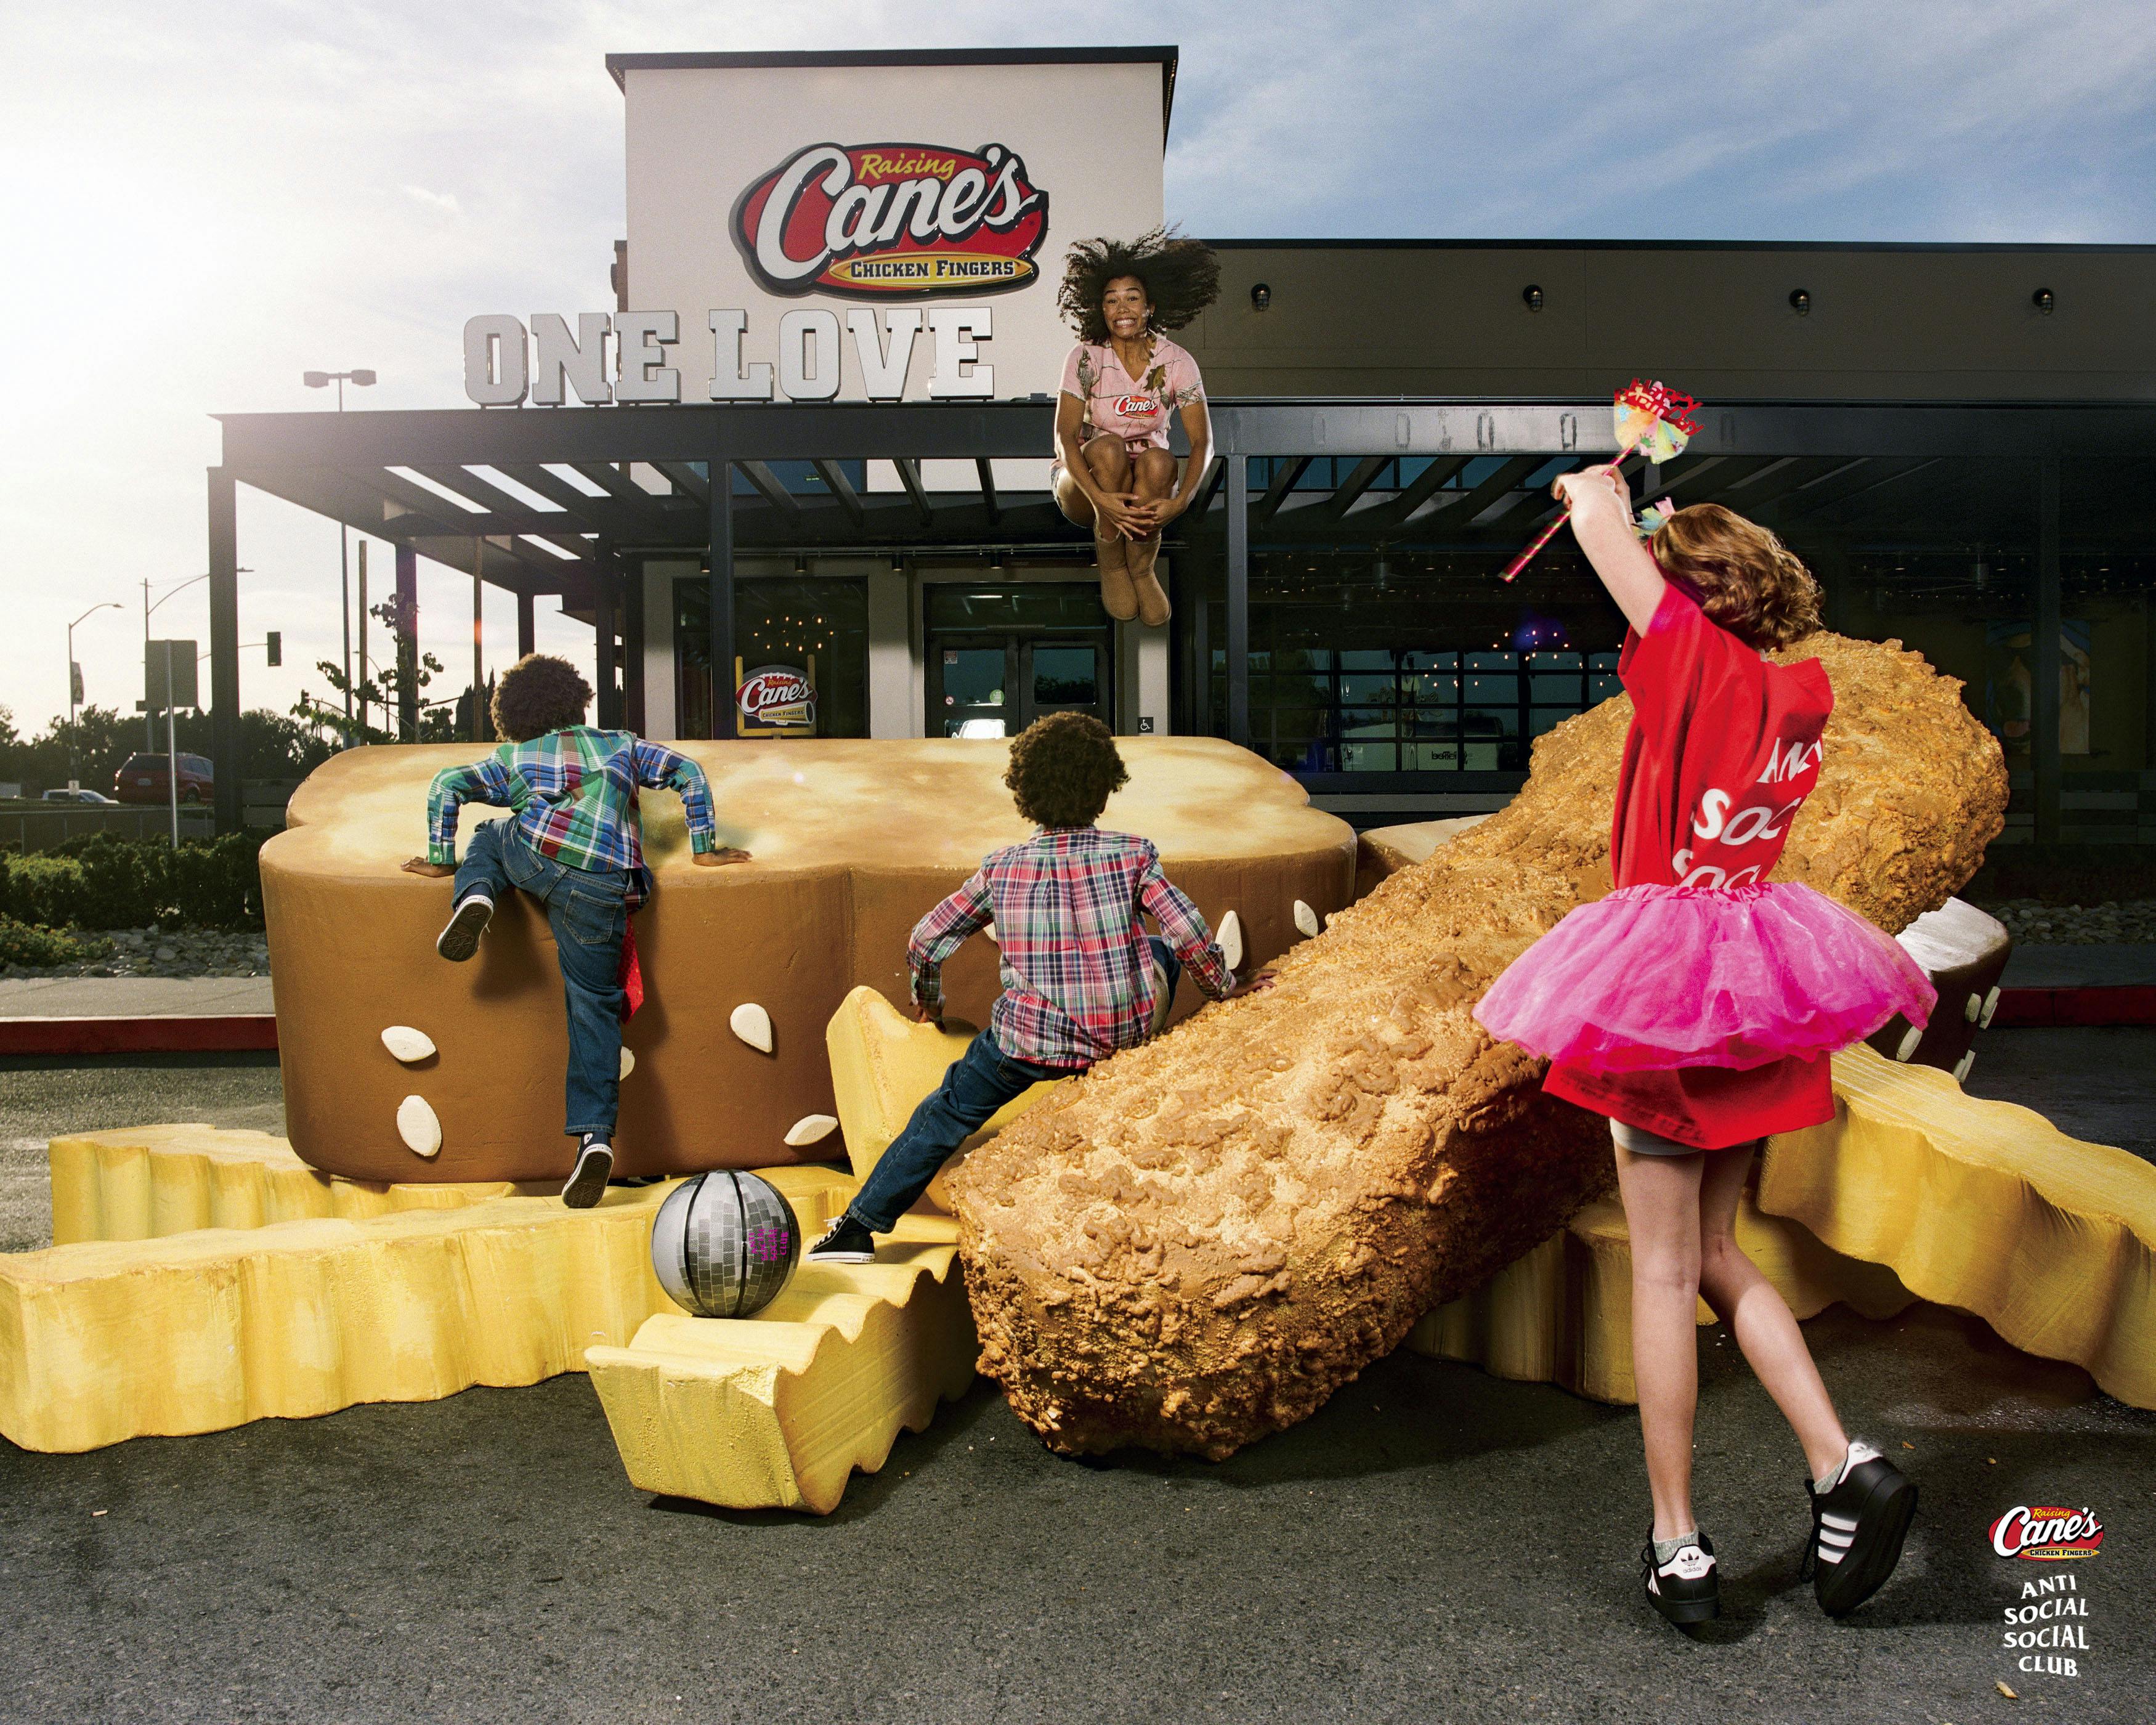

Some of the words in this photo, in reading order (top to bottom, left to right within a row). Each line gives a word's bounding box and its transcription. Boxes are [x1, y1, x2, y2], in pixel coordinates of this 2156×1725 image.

[858, 153, 956, 180] Raising
[756, 147, 1039, 280] Cane's
[851, 261, 929, 277] CHICKEN
[936, 259, 1013, 276] FINGERS
[463, 310, 681, 405] ONE
[708, 306, 994, 402] LOVE
[741, 676, 813, 712] Cane's
[768, 679, 793, 687] Raising
[768, 1227, 778, 1261] SOCIAL
[780, 1232, 788, 1256] CLUB
